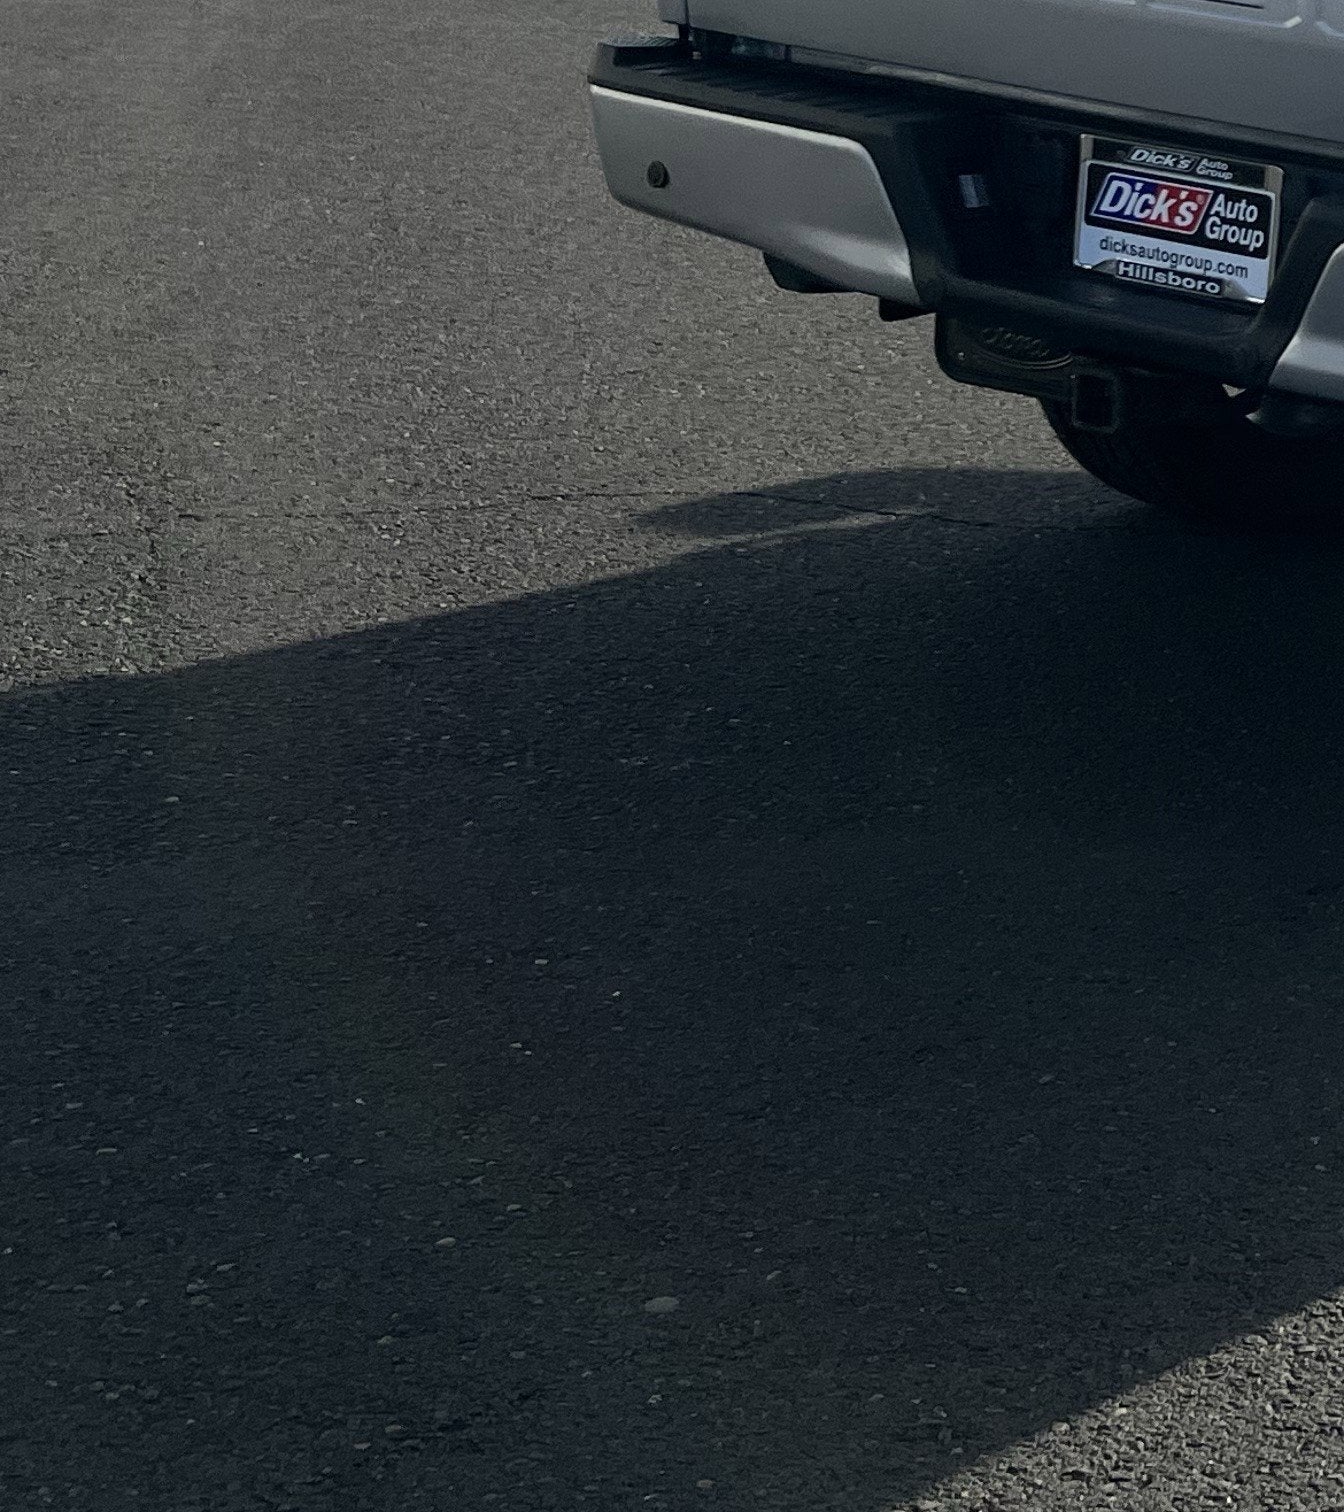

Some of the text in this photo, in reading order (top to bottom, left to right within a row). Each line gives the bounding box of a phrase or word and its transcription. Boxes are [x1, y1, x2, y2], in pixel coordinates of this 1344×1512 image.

[1130, 149, 1193, 170] Dick's
[1196, 167, 1234, 181] Group
[1200, 157, 1229, 171] Auto
[1099, 179, 1198, 227] Dick's
[1210, 193, 1259, 223] Auto
[1204, 217, 1265, 252] Group
[1099, 236, 1249, 279] dicksautogroup.com
[1117, 260, 1221, 294] Hillsboro
